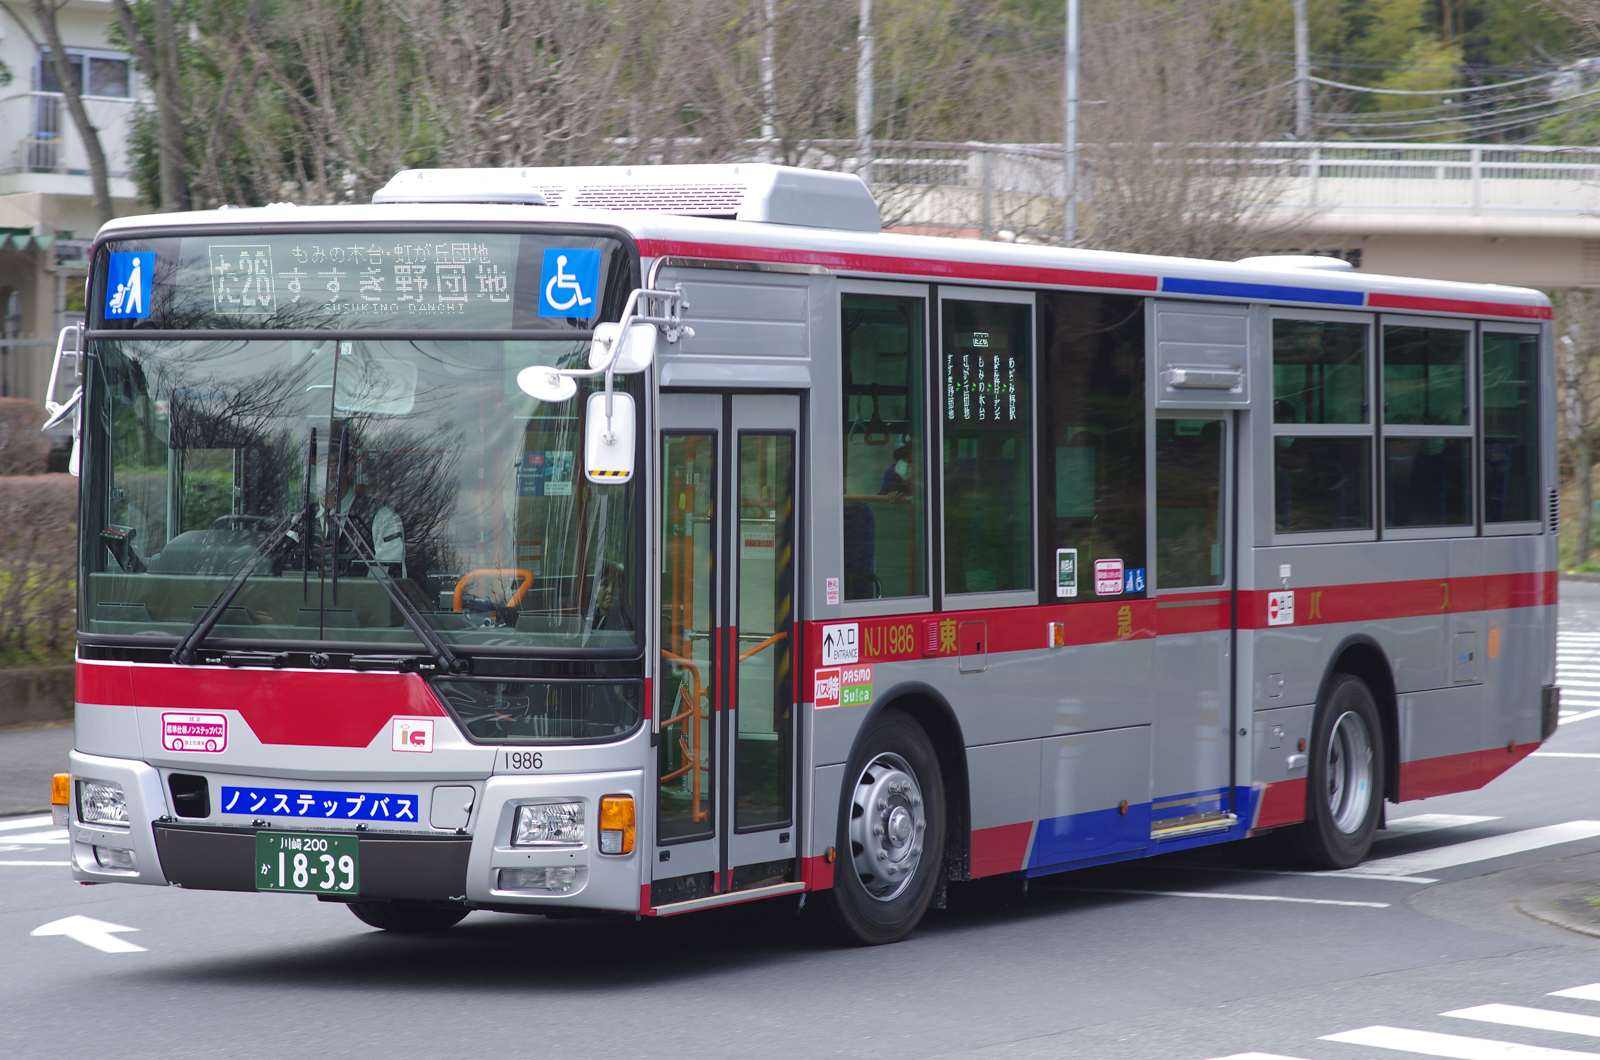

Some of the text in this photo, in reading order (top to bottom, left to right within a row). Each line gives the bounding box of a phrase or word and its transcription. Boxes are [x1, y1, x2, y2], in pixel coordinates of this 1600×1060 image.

[215, 251, 271, 306] た26
[279, 264, 510, 303] すすき野団地
[837, 628, 855, 646] 入口
[864, 624, 914, 657] NJ1986
[940, 618, 957, 654] 東
[1117, 606, 1132, 637] 急
[833, 648, 858, 660] ENTRANCE
[842, 668, 871, 683] PASMO
[843, 689, 870, 703] Suica
[505, 752, 543, 770] 1986
[225, 790, 414, 820] ノンステップバス
[261, 863, 271, 875] か
[278, 852, 355, 890] 18-39
